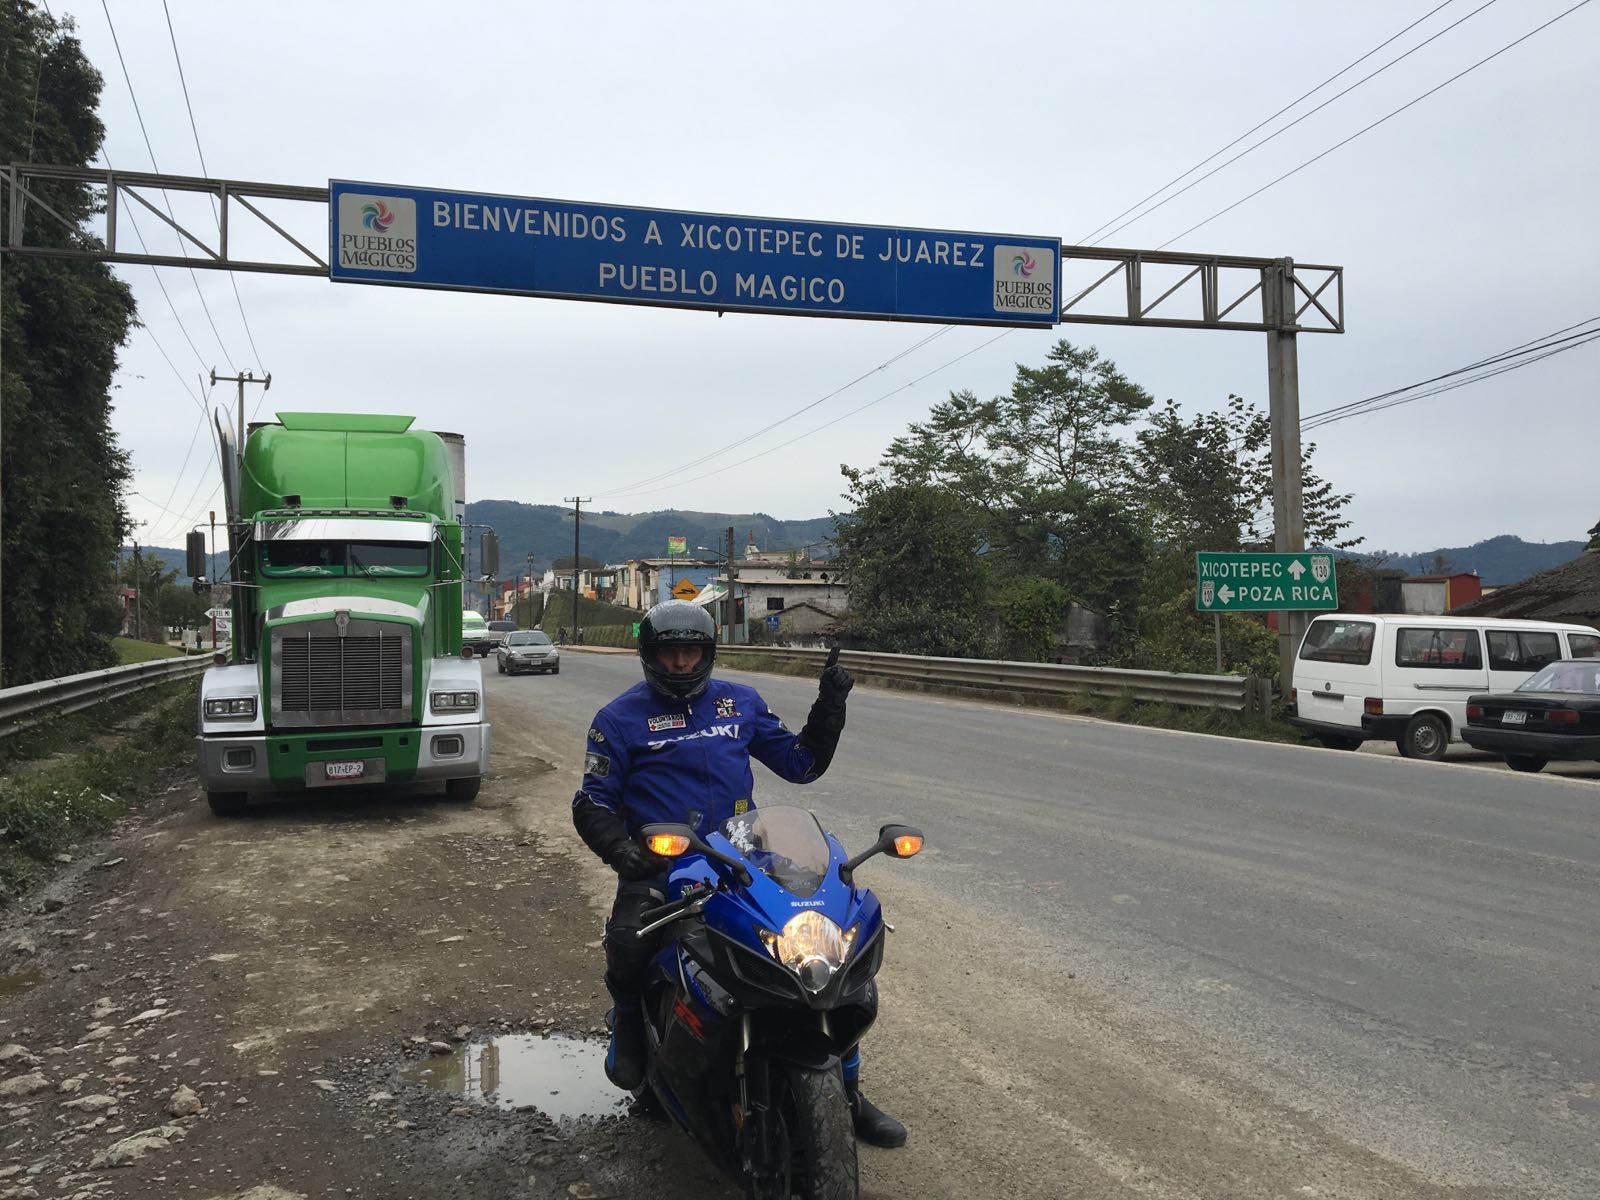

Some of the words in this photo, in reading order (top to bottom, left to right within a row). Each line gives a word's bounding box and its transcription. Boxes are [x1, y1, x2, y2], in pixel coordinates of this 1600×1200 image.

[433, 201, 627, 242] BIENVENIDOS
[643, 220, 663, 246] A
[680, 222, 823, 257] XICOTEPEC
[836, 234, 865, 260] DE
[878, 237, 985, 267] JUAREZ
[341, 234, 415, 253] PUEBLOS
[599, 262, 718, 296] PUEBLO
[735, 272, 845, 304] MAGICO
[996, 280, 1052, 295] PUEBLOS
[1201, 562, 1283, 578] XICOTEPEC
[1315, 565, 1328, 578] 130
[1239, 586, 1285, 602] POZA
[1292, 586, 1333, 601] RICA
